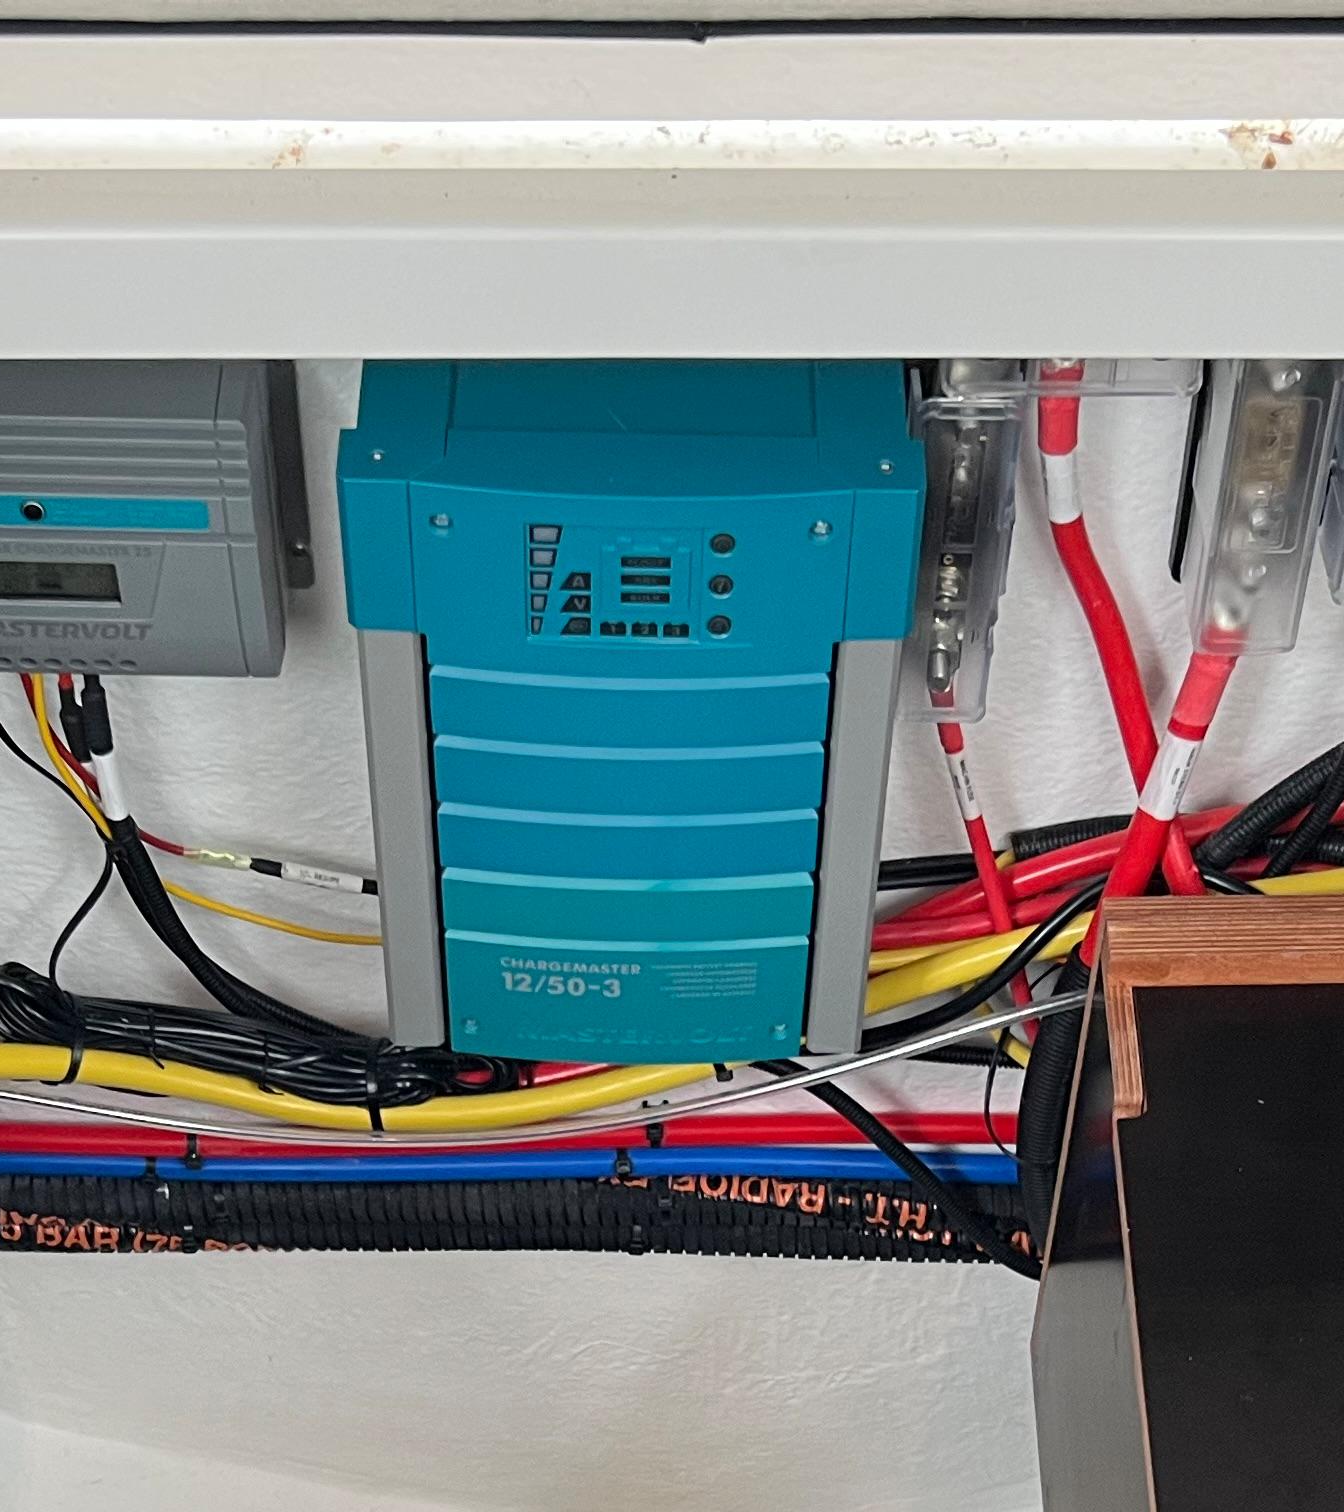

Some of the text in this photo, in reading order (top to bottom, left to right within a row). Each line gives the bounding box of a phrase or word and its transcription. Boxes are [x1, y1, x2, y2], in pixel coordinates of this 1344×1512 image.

[572, 575, 586, 588] A
[574, 597, 588, 610] V
[500, 956, 642, 976] CHARGEMASTER
[501, 971, 622, 999] 12/50-3
[36, 1219, 120, 1250] BAR
